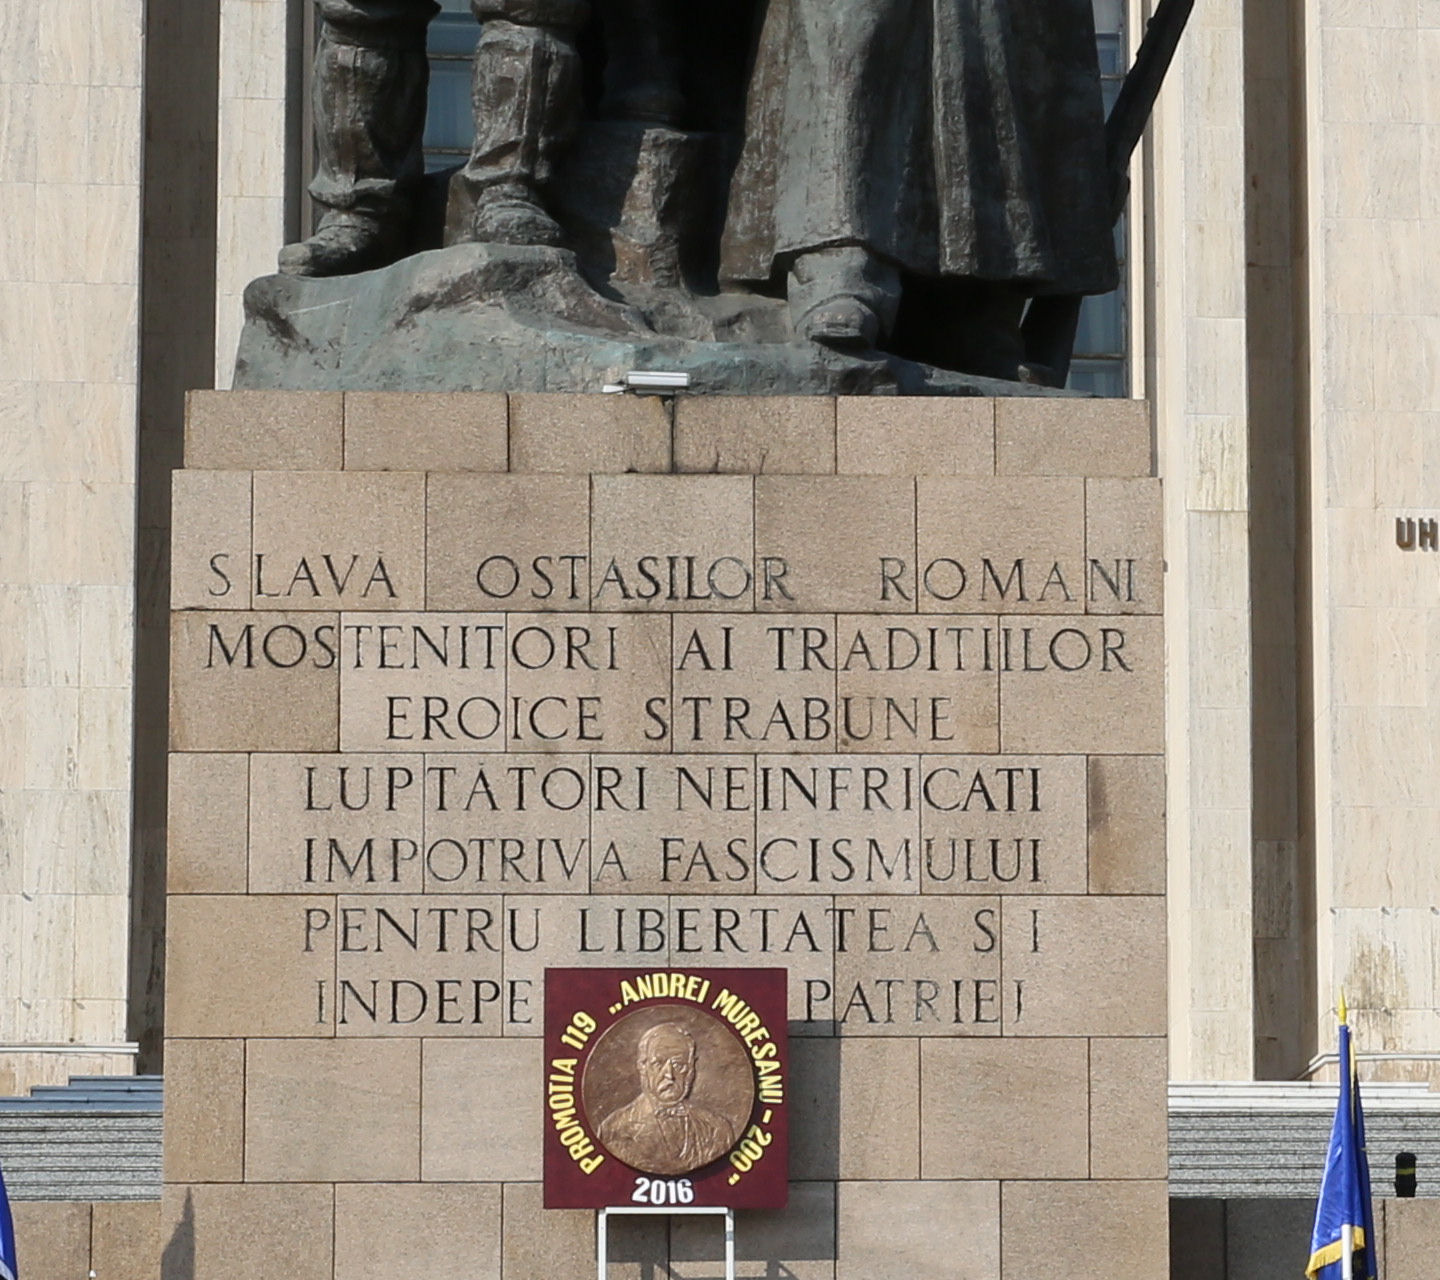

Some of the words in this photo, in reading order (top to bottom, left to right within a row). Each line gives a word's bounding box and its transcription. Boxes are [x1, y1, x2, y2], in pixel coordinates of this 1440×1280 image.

[476, 554, 795, 601] OSTASILOR
[878, 557, 1137, 602] ROMANI
[204, 624, 619, 670] MOSTENITORI
[675, 627, 734, 671] AI
[766, 627, 1134, 672] TRADITIILOR
[386, 696, 603, 740] EROICE
[644, 697, 956, 741] STRABUNE
[675, 766, 1042, 812] NEINFRICATI
[304, 838, 633, 883] IMPOTRIVA
[660, 837, 1042, 882] FASCISMULUI
[303, 908, 541, 953] PENTRU
[578, 908, 941, 953] LIBERTATEA
[803, 979, 1027, 1024] PATRIEI
[561, 1011, 597, 1050] 119
[712, 989, 783, 1104] MURESANU
[548, 1058, 605, 1175] PROMOTIA
[632, 1177, 694, 1205] 2016
